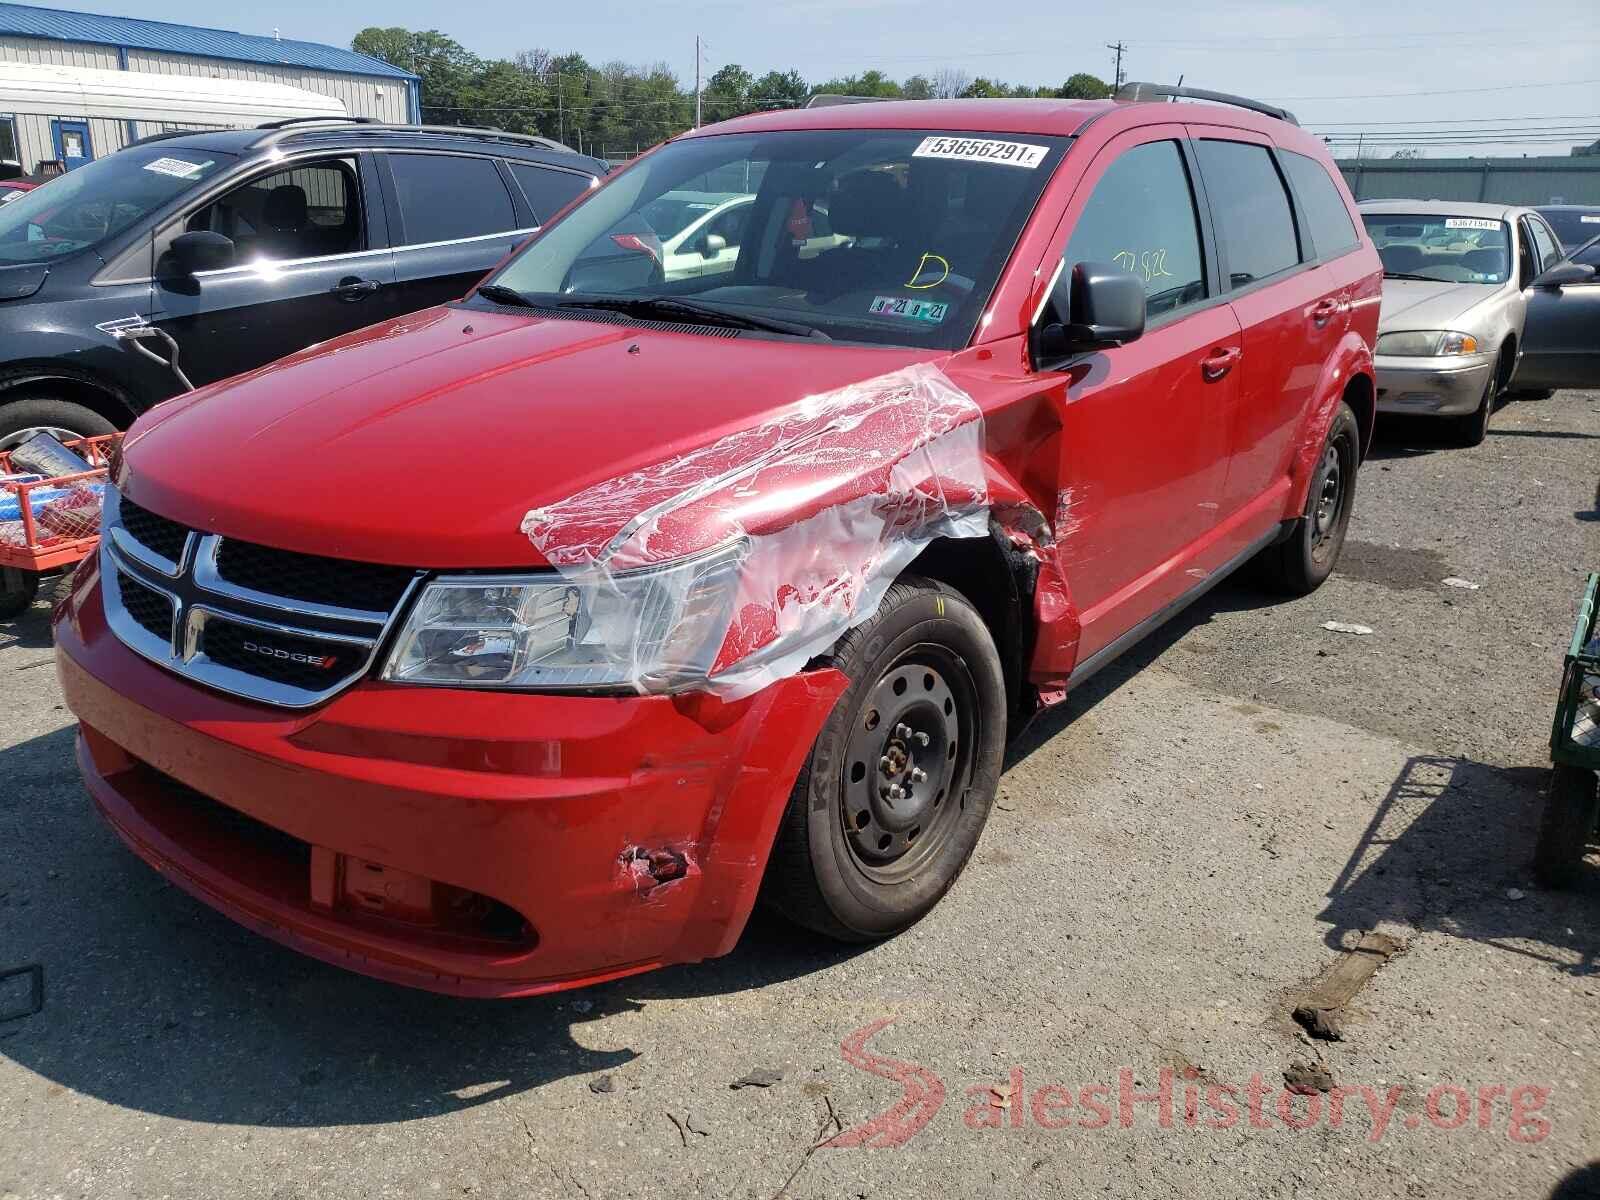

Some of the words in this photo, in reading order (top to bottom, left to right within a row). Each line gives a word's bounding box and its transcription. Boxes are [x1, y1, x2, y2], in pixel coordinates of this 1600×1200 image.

[930, 138, 1029, 162] 53656291
[903, 251, 949, 289] D
[894, 299, 908, 314] 21
[931, 303, 945, 319] 21
[242, 641, 324, 666] DODGE
